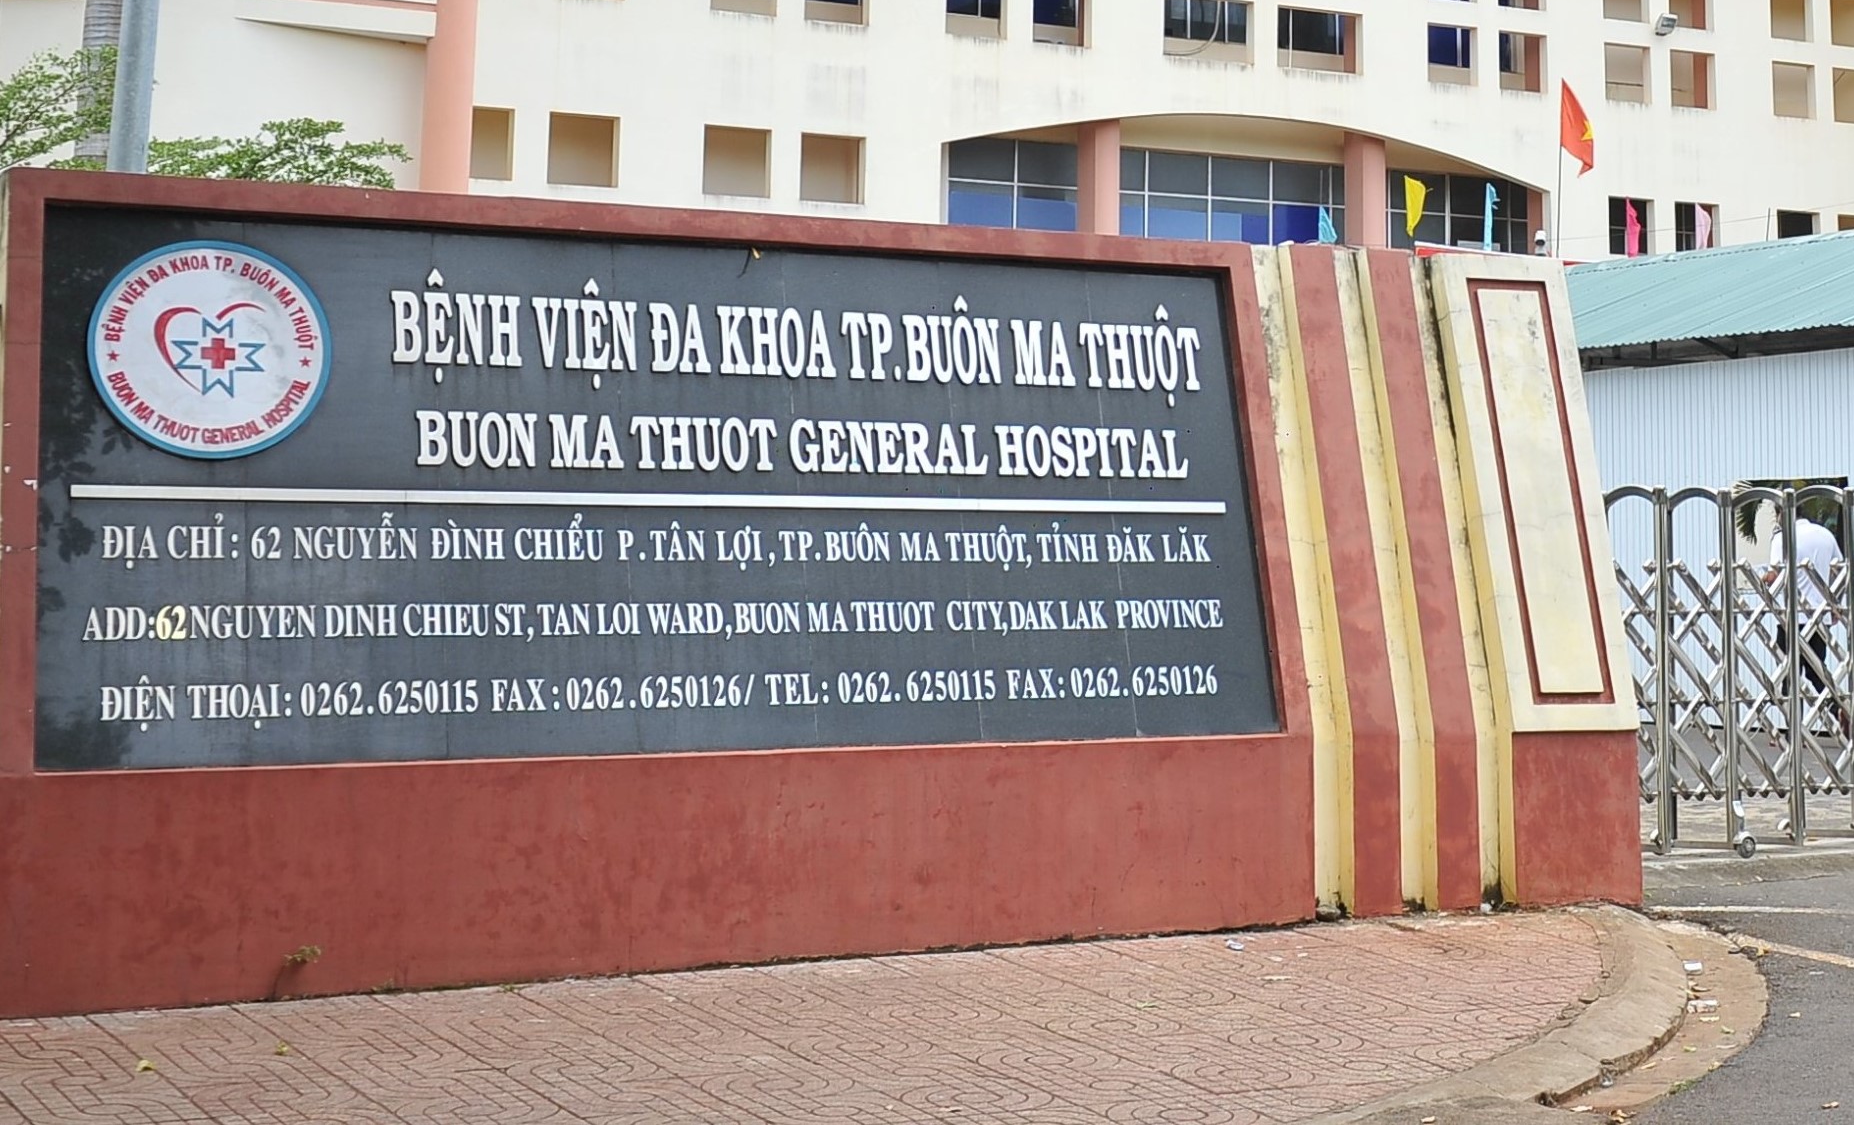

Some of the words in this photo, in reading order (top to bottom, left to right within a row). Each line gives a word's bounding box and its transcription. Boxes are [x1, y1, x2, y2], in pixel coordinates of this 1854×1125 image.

[102, 305, 129, 342] BỆNH
[119, 280, 149, 305] VIỆN
[147, 264, 169, 283] ĐA
[169, 255, 209, 274] KHOA
[214, 255, 236, 273] TP.
[240, 263, 279, 292] BUÔN
[274, 286, 297, 309] MA
[289, 306, 319, 350] THUỘT
[391, 268, 522, 384] BỆNH
[532, 278, 638, 389] VIỆN
[648, 302, 712, 374] ĐA
[716, 305, 836, 378] KHOA
[1010, 319, 1077, 387] MA
[1078, 304, 1201, 407] THUỘT
[107, 371, 134, 407] BUON
[130, 399, 153, 424] MA
[151, 413, 200, 443] THUOT
[201, 420, 265, 445] GENERAL
[261, 379, 312, 428] HOSPITAL
[416, 410, 538, 468] BUON
[548, 413, 624, 469] MA
[630, 415, 777, 472] THUOT
[789, 419, 989, 475] GENERAL
[995, 424, 1189, 478] HOSPITAL
[102, 525, 158, 569] ĐỊA
[251, 526, 282, 560] 62
[293, 511, 417, 560] NGUYỄN
[431, 518, 504, 561] ĐÌNH
[514, 513, 603, 561] CHIỂU
[901, 532, 941, 562] MA
[1036, 521, 1099, 563] TỈNH
[1106, 525, 1155, 563] ĐĂK
[1162, 526, 1211, 563] LĂK
[190, 605, 317, 639] NGUYEN
[323, 604, 398, 637] DINH
[403, 603, 490, 637] CHIEU
[596, 602, 642, 635] LOI
[807, 602, 848, 634] MA
[851, 600, 935, 633] THUOT
[1061, 599, 1108, 630] LAK
[1116, 598, 1224, 629] PROVINCE
[100, 674, 176, 732] ĐIỆN
